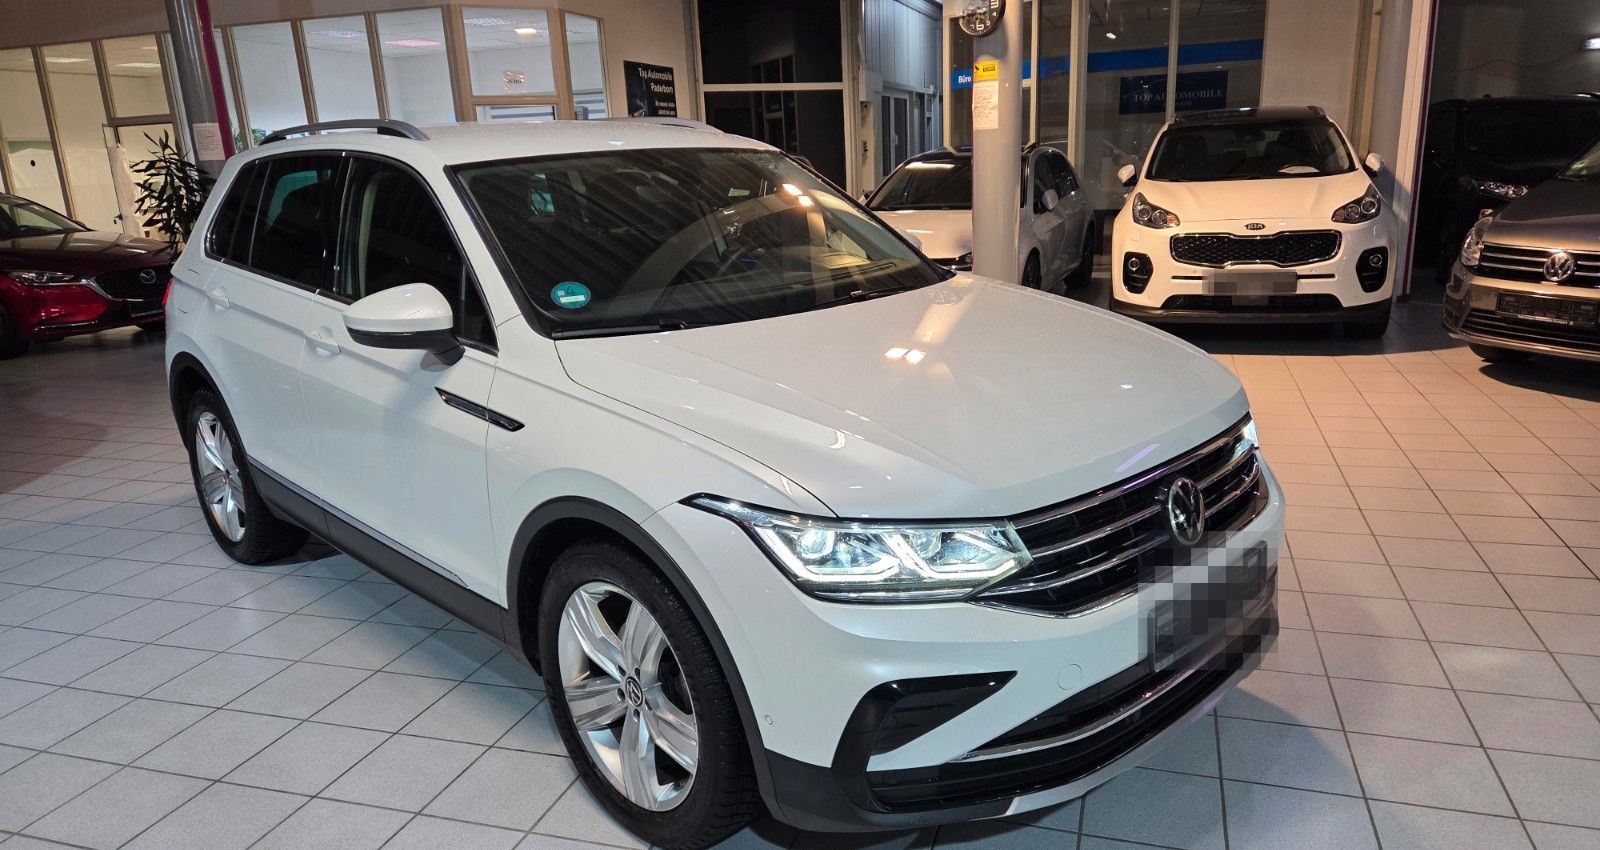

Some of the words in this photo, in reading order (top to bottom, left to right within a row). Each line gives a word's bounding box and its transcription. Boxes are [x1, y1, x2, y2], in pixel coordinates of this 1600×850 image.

[976, 21, 984, 30] 6
[648, 70, 673, 80] Automobile
[958, 75, 971, 83] Büro
[650, 82, 674, 93] Paderborn
[1134, 94, 1153, 102] TOP
[1156, 89, 1223, 100] AUOMOBILE
